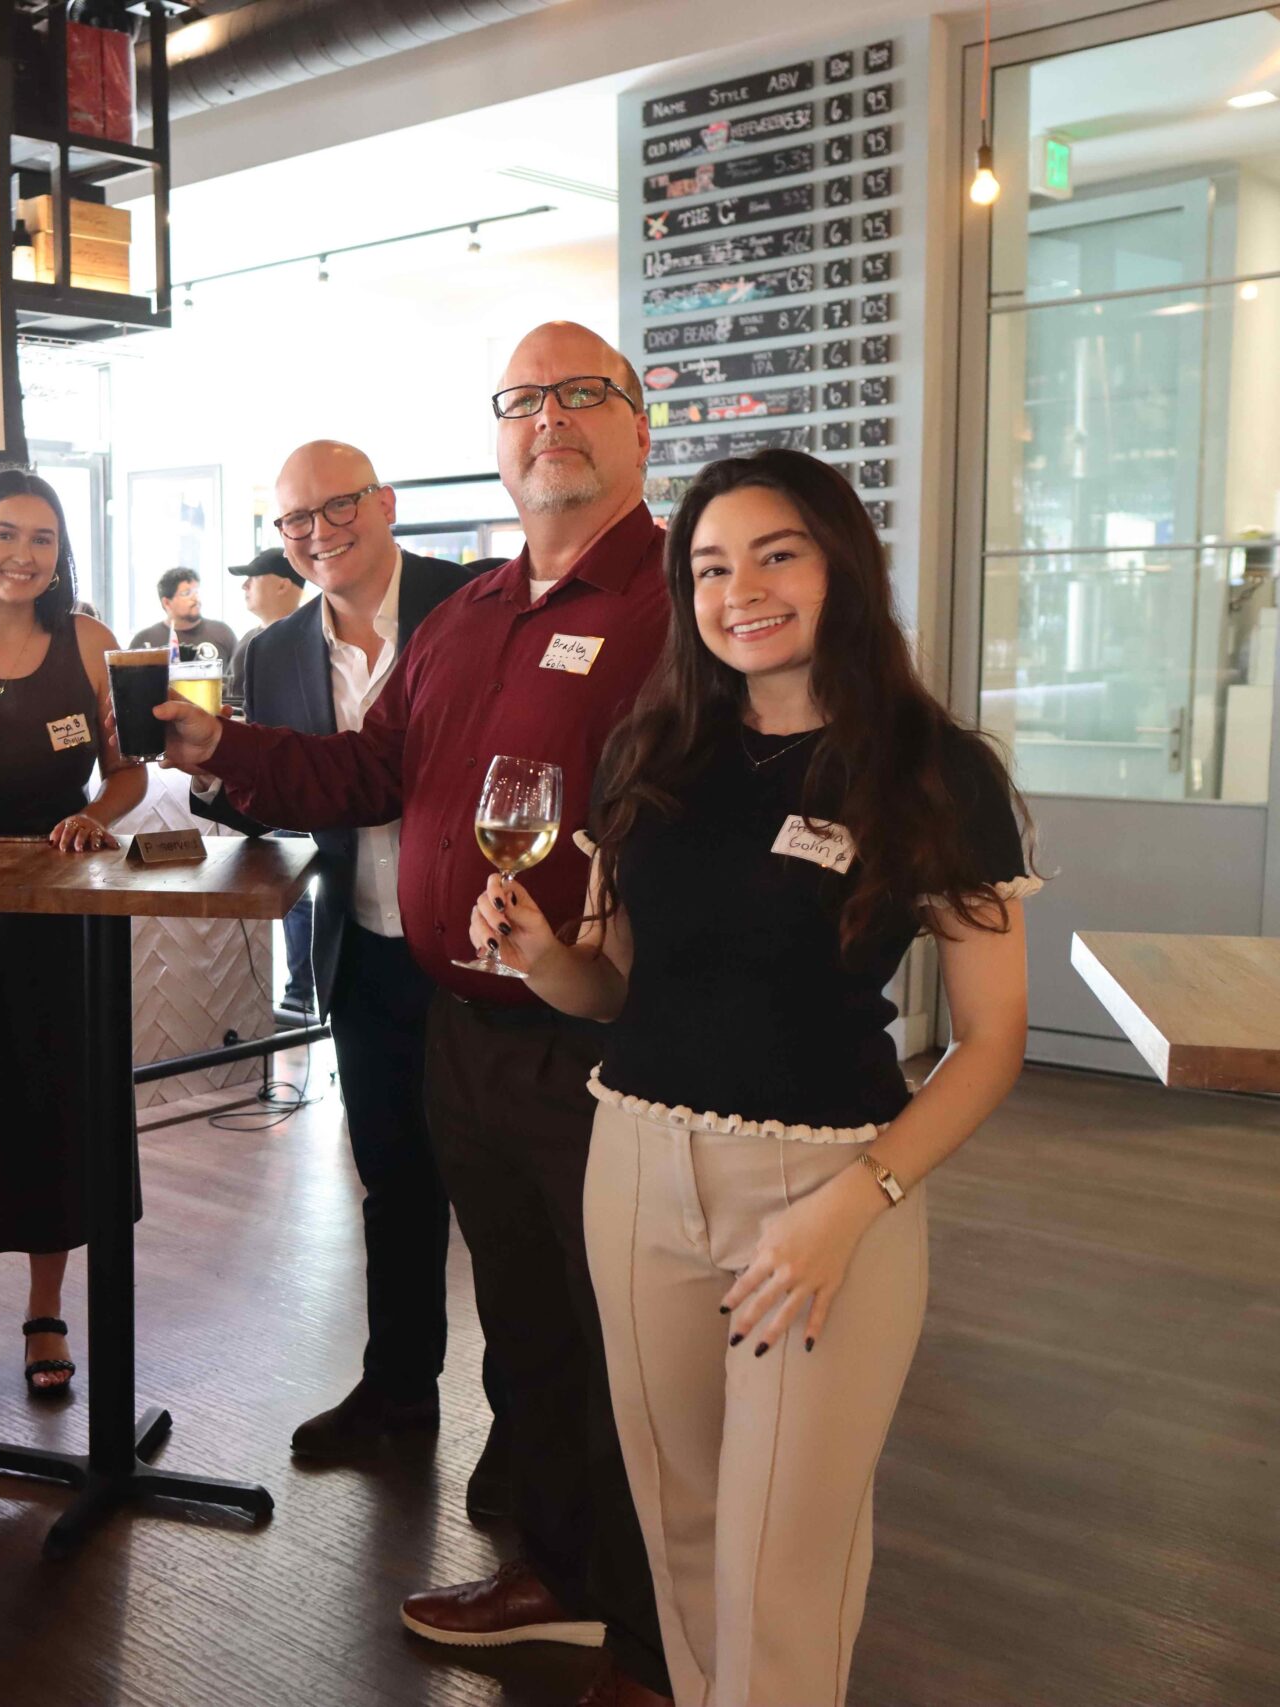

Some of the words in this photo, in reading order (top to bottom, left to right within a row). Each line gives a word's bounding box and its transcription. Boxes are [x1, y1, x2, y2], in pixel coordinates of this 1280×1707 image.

[652, 100, 687, 118] NAME
[708, 87, 750, 106] STYLE
[767, 71, 800, 92] ABV
[831, 99, 842, 121] 6
[647, 143, 668, 158] OLD
[669, 137, 692, 152] MAN
[831, 142, 842, 161] 6
[831, 182, 842, 203] 6
[677, 206, 712, 229] THE
[830, 223, 842, 244] 6
[830, 264, 842, 284] 6
[831, 304, 843, 325] 7
[648, 328, 680, 348] DROP
[683, 324, 716, 344] BEAR
[830, 343, 842, 364] 6
[751, 360, 775, 376] IPA
[830, 387, 842, 405] 6
[552, 638, 587, 659] Bradley
[789, 835, 830, 857] Golin
